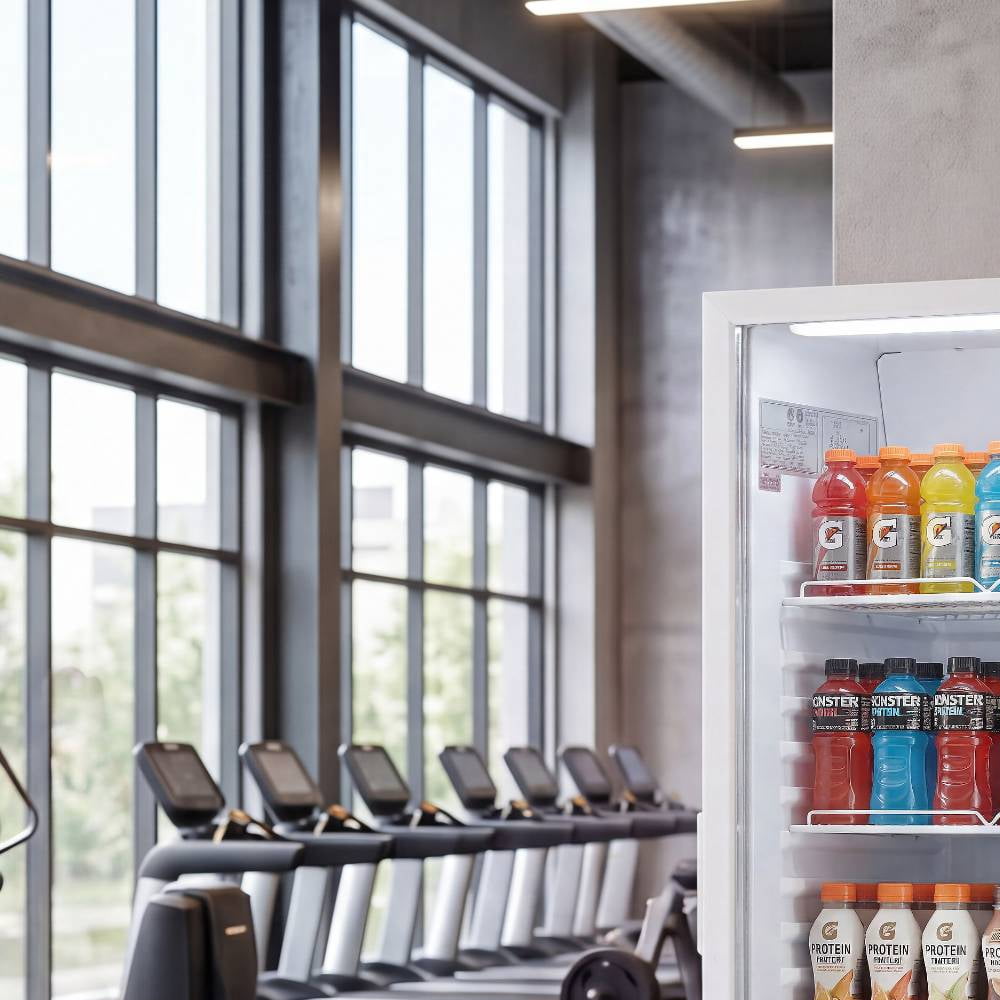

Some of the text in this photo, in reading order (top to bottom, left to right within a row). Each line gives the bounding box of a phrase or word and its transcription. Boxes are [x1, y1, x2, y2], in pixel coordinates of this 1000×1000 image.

[811, 943, 851, 955] PROTEIN
[868, 944, 909, 956] PROTEIN
[925, 944, 967, 956] PROTEIN
